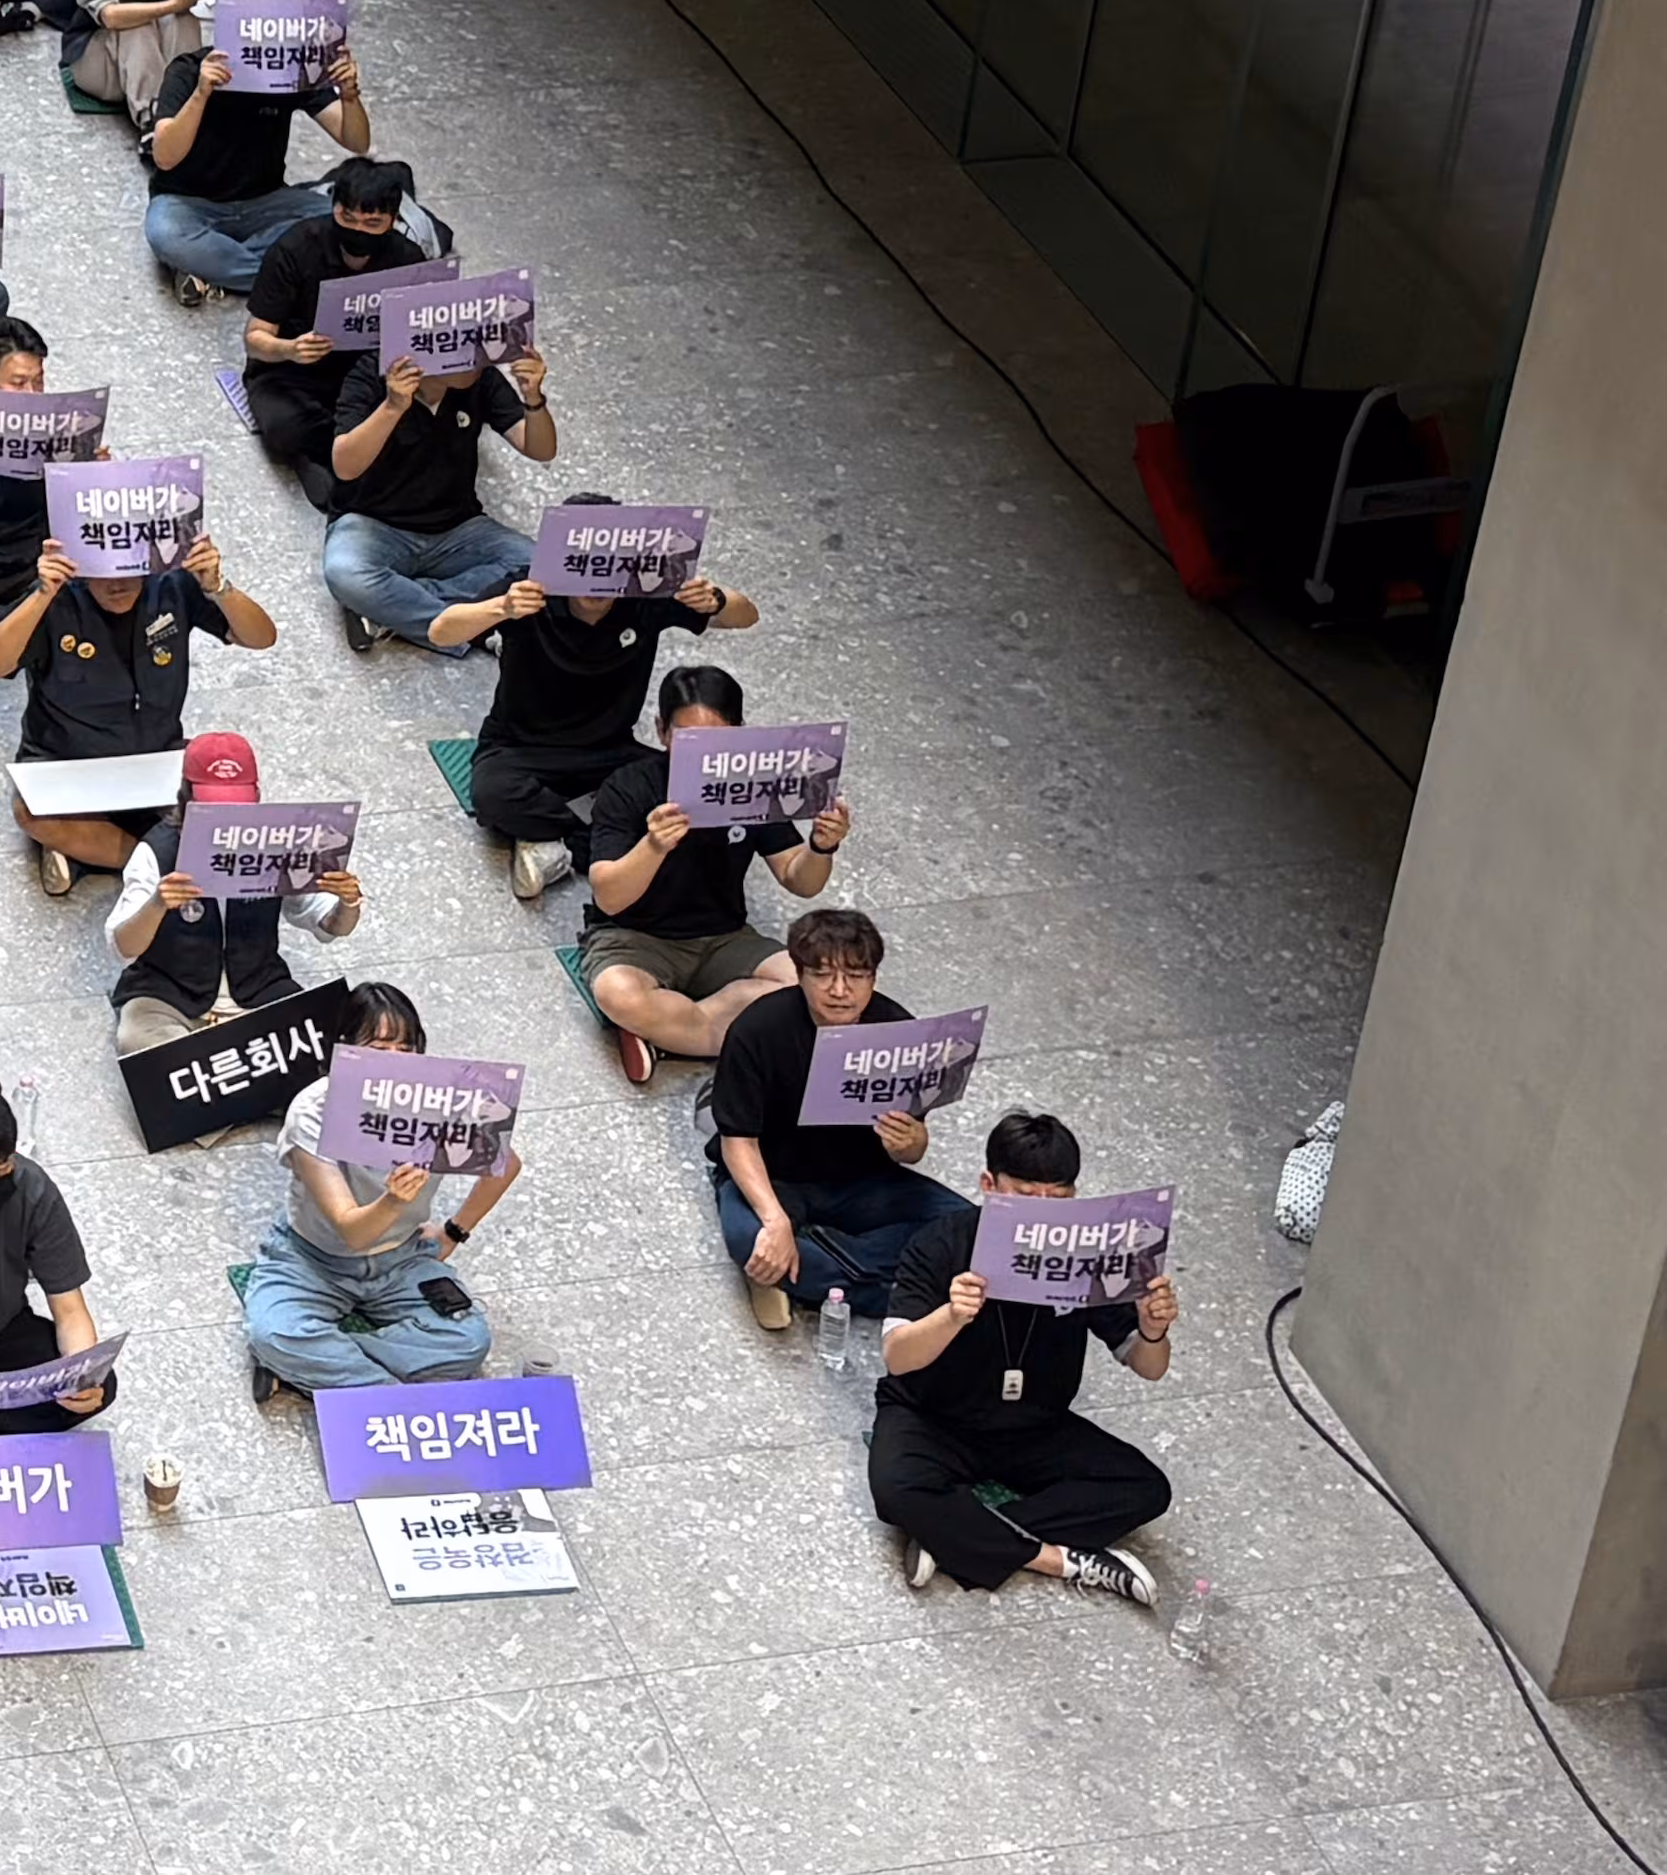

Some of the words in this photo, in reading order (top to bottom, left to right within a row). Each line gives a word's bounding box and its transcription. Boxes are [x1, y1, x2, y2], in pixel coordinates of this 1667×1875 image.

[239, 17, 325, 41] 네이버가
[239, 45, 323, 69] 책임져라
[409, 295, 505, 330] 네이버가
[409, 323, 505, 355] 책임져라
[76, 485, 178, 516] 네이버가
[79, 517, 179, 549] 책임져라
[567, 526, 670, 551] 네이버가
[563, 554, 668, 576] 책임져라
[702, 747, 811, 777] 네이버가
[700, 777, 806, 804] 책임져라
[212, 825, 322, 850] 네이버가
[209, 853, 319, 876] 책임져라
[167, 1021, 325, 1105] 다른회사
[843, 1037, 953, 1076] 네이버가
[362, 1079, 485, 1114] 네이버가
[841, 1070, 946, 1103] 책임져라
[359, 1113, 479, 1147] 책임져라
[1013, 1220, 1138, 1251] 네이버가
[1009, 1253, 1137, 1281] 책임져라
[364, 1406, 541, 1463] 책임져라
